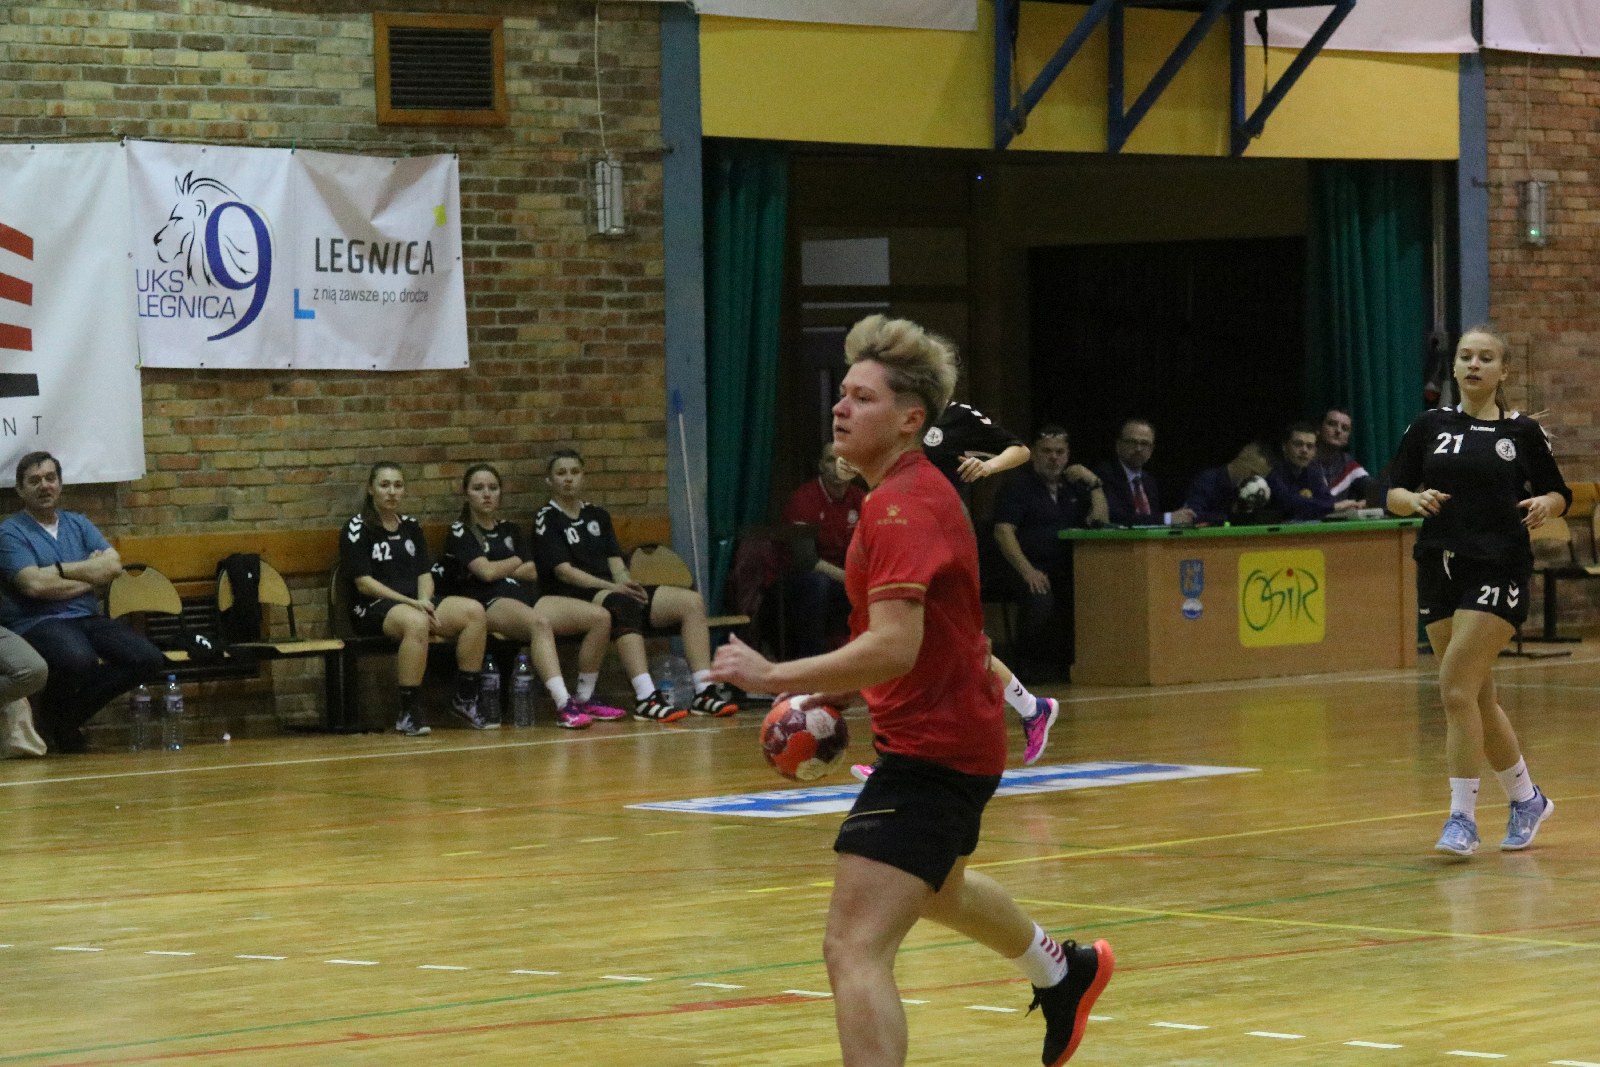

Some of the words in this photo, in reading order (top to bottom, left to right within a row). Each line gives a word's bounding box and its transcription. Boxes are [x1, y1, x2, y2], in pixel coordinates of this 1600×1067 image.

[315, 237, 435, 275] LEGNICA
[136, 269, 184, 293] UKS
[205, 201, 272, 341] 9
[137, 294, 236, 319] LEGNICA
[313, 288, 319, 300] z
[321, 286, 337, 304] nią
[339, 289, 379, 302] zawsze
[382, 291, 396, 305] po
[1433, 431, 1464, 455] 21
[371, 541, 393, 561] 42
[1477, 585, 1500, 607] 21
